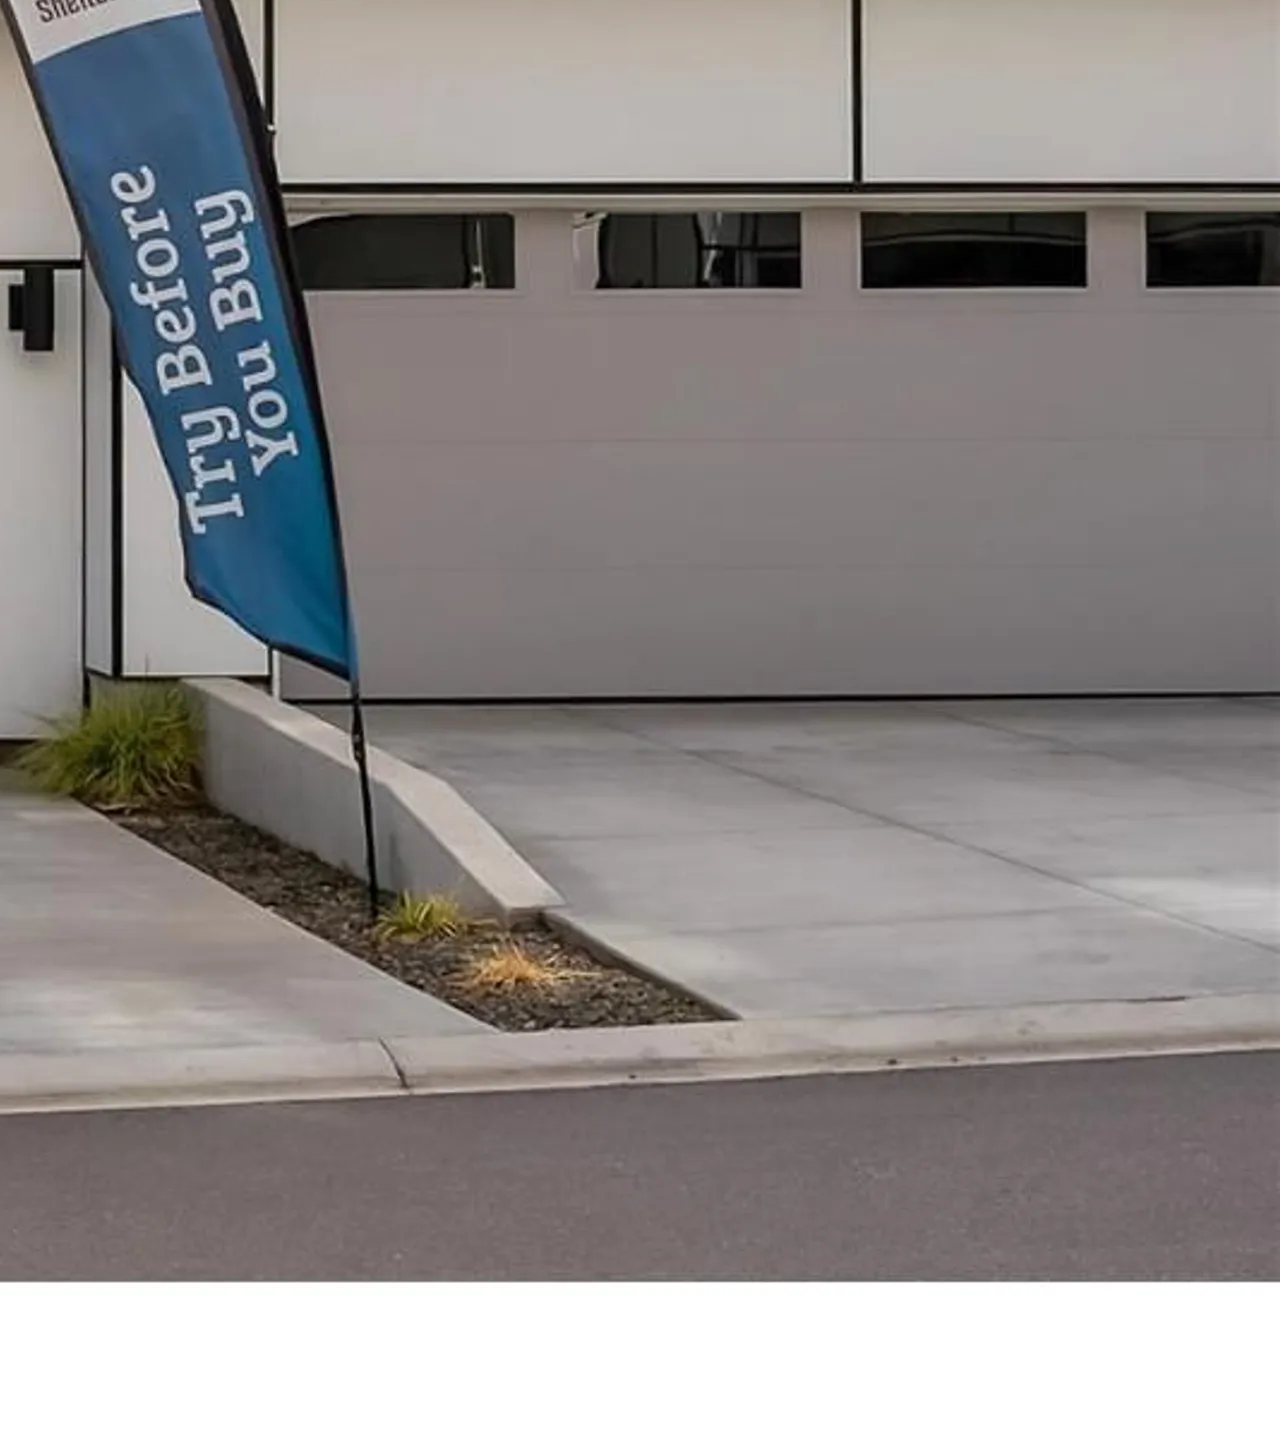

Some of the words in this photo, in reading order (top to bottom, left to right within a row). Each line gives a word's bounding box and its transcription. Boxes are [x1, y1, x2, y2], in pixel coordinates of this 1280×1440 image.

[110, 165, 213, 395] Before
[195, 189, 264, 331] Buy
[181, 406, 245, 534] Try
[237, 339, 299, 477] You
